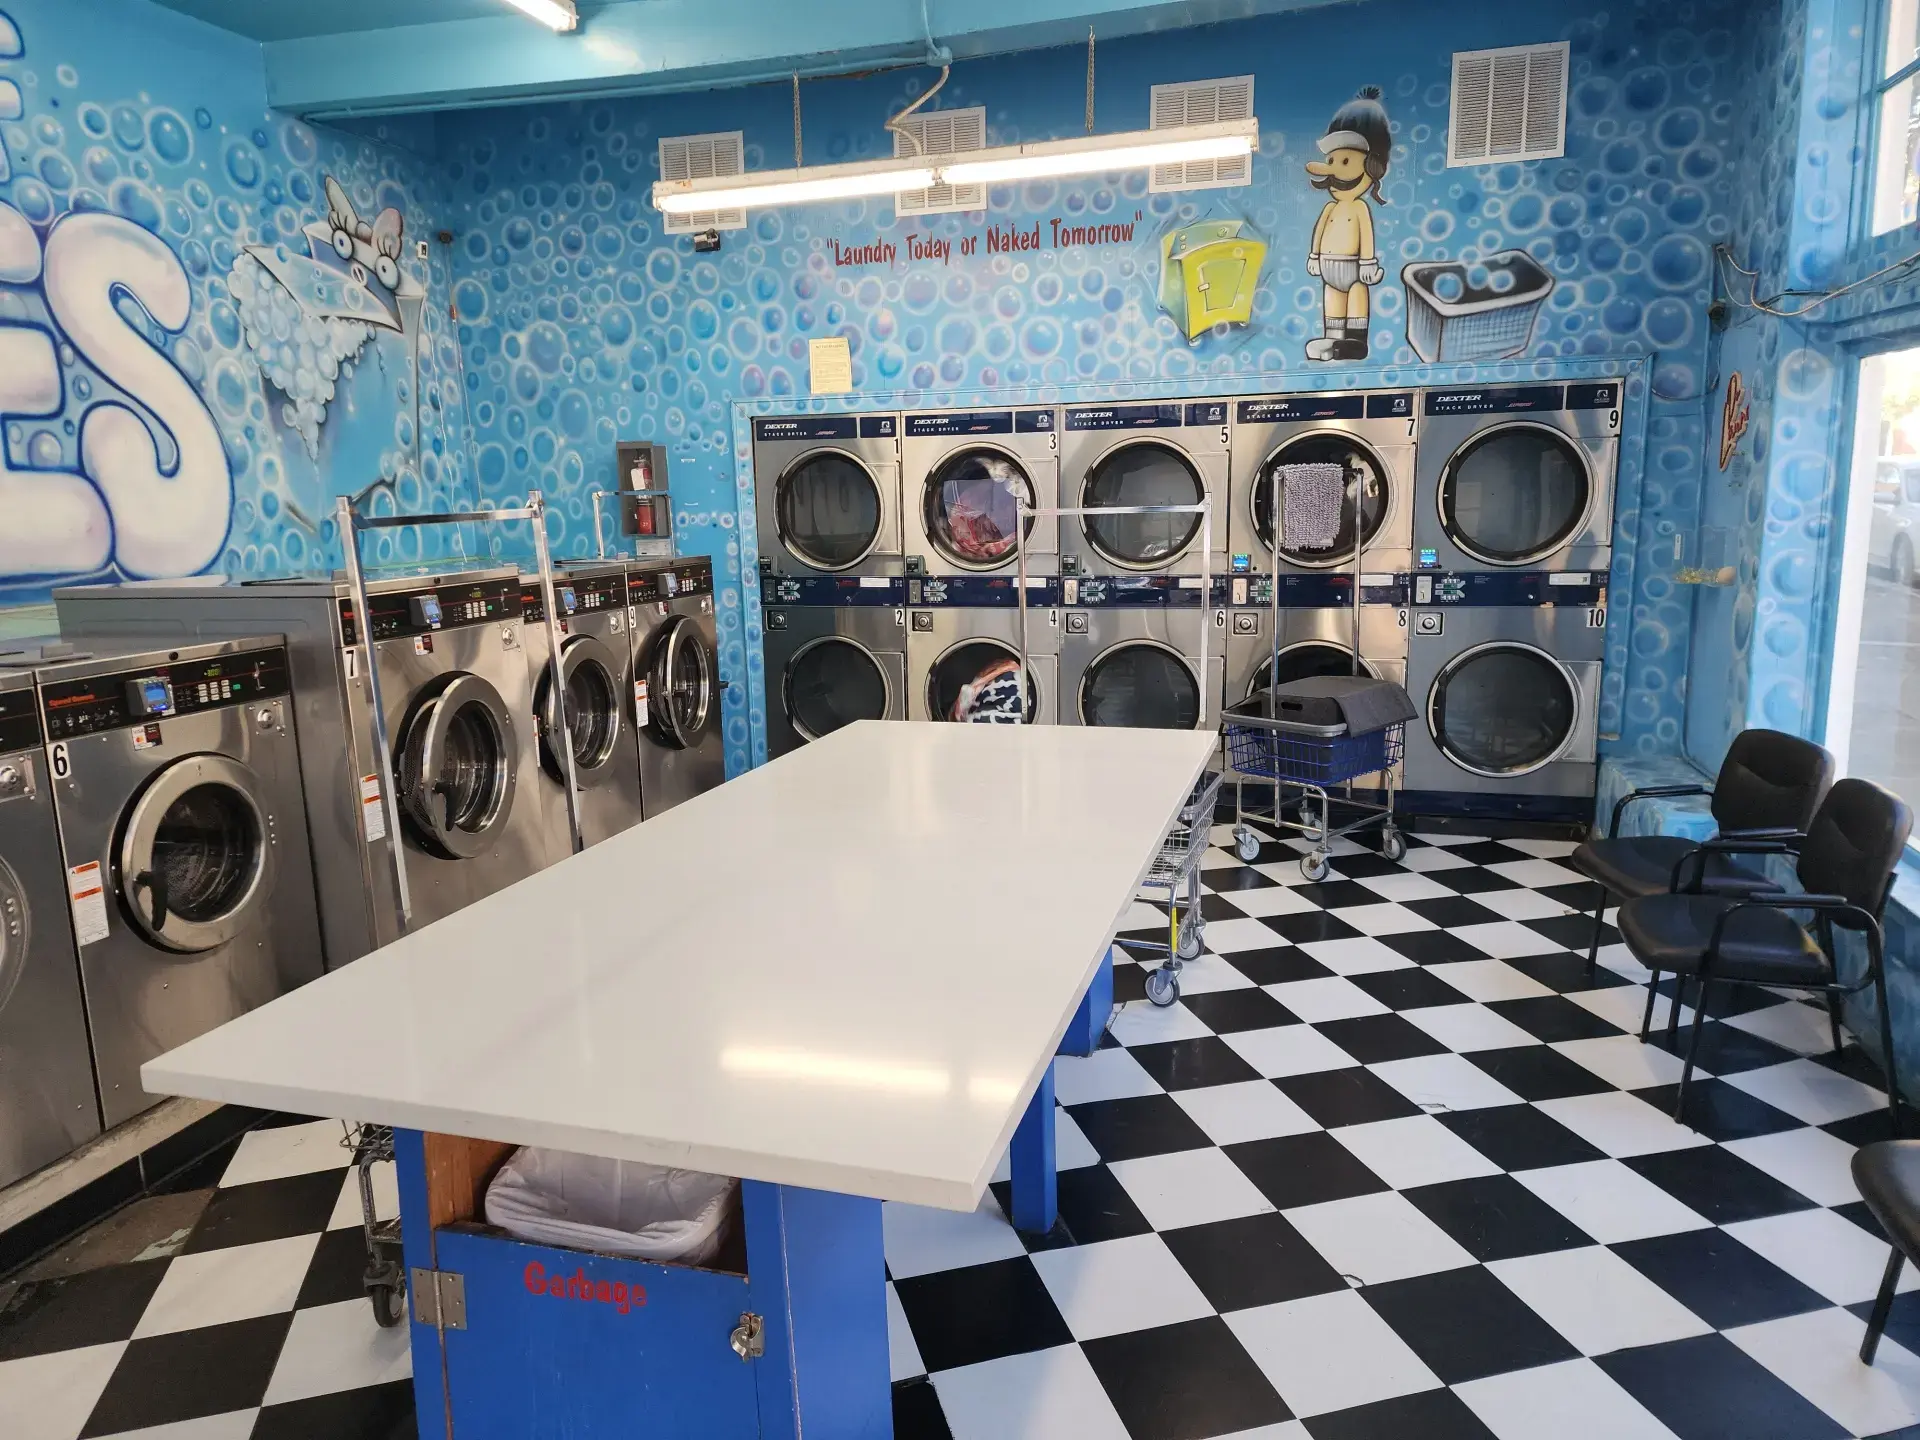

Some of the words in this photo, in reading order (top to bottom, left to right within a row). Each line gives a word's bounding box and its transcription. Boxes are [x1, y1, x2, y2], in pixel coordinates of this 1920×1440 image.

[826, 237, 898, 269] "Laundry
[905, 231, 951, 265] Today
[961, 234, 977, 256] or
[986, 220, 1040, 254] Naked
[1050, 209, 1143, 249] Tomorrow"
[1247, 403, 1289, 411] DEXTER
[1436, 394, 1482, 403] DEXTER
[1074, 411, 1113, 419] DEXTER
[1609, 410, 1619, 429] 9
[1221, 426, 1229, 443] 5
[1407, 418, 1416, 436] 7
[894, 438, 899, 454] 1
[1049, 433, 1057, 449] 3
[896, 610, 903, 625] 2
[1050, 610, 1057, 625] 4
[1216, 610, 1224, 626] 6
[1398, 610, 1406, 627] 8
[1588, 608, 1604, 627] 10
[346, 650, 355, 676] 7
[53, 744, 68, 776] 6
[523, 1260, 648, 1315] Garbage
